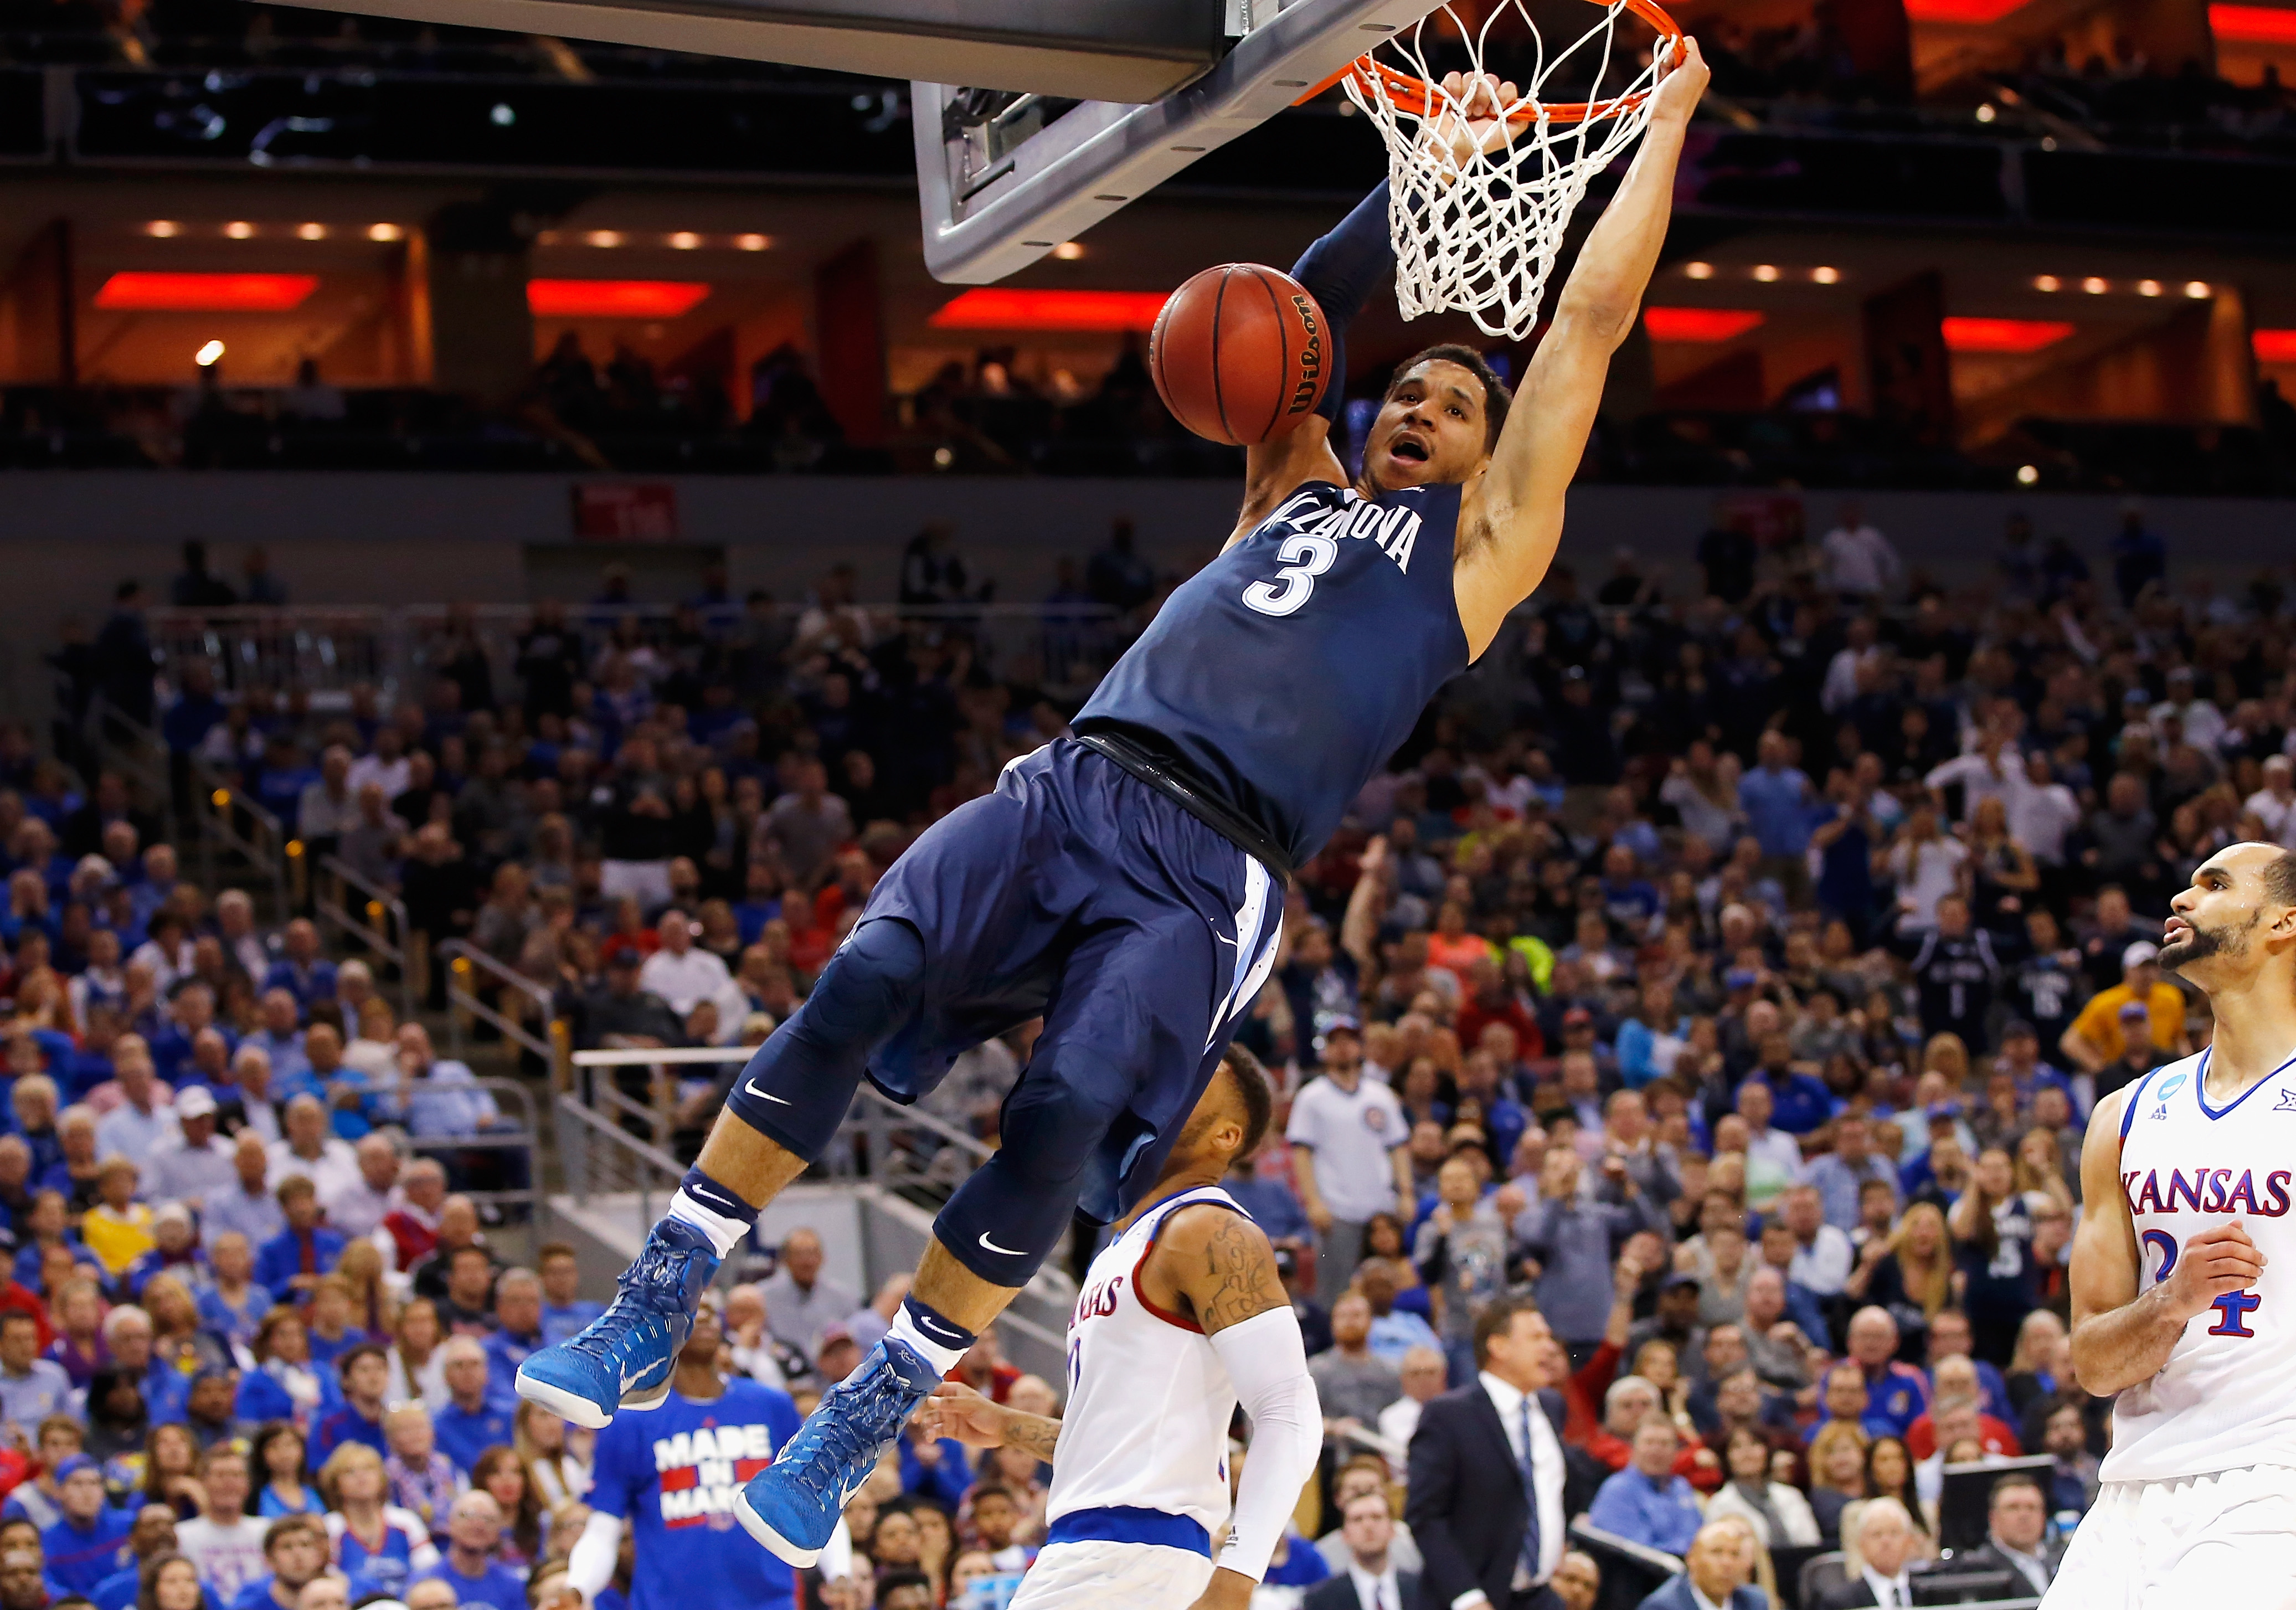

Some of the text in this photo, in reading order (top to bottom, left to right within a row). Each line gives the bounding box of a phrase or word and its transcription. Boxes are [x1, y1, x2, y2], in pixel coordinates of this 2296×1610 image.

[1288, 295, 1322, 415] Wilson
[1241, 533, 1339, 617] 3
[2123, 1168, 2292, 1218] KANSAS
[653, 1423, 773, 1472] MADE
